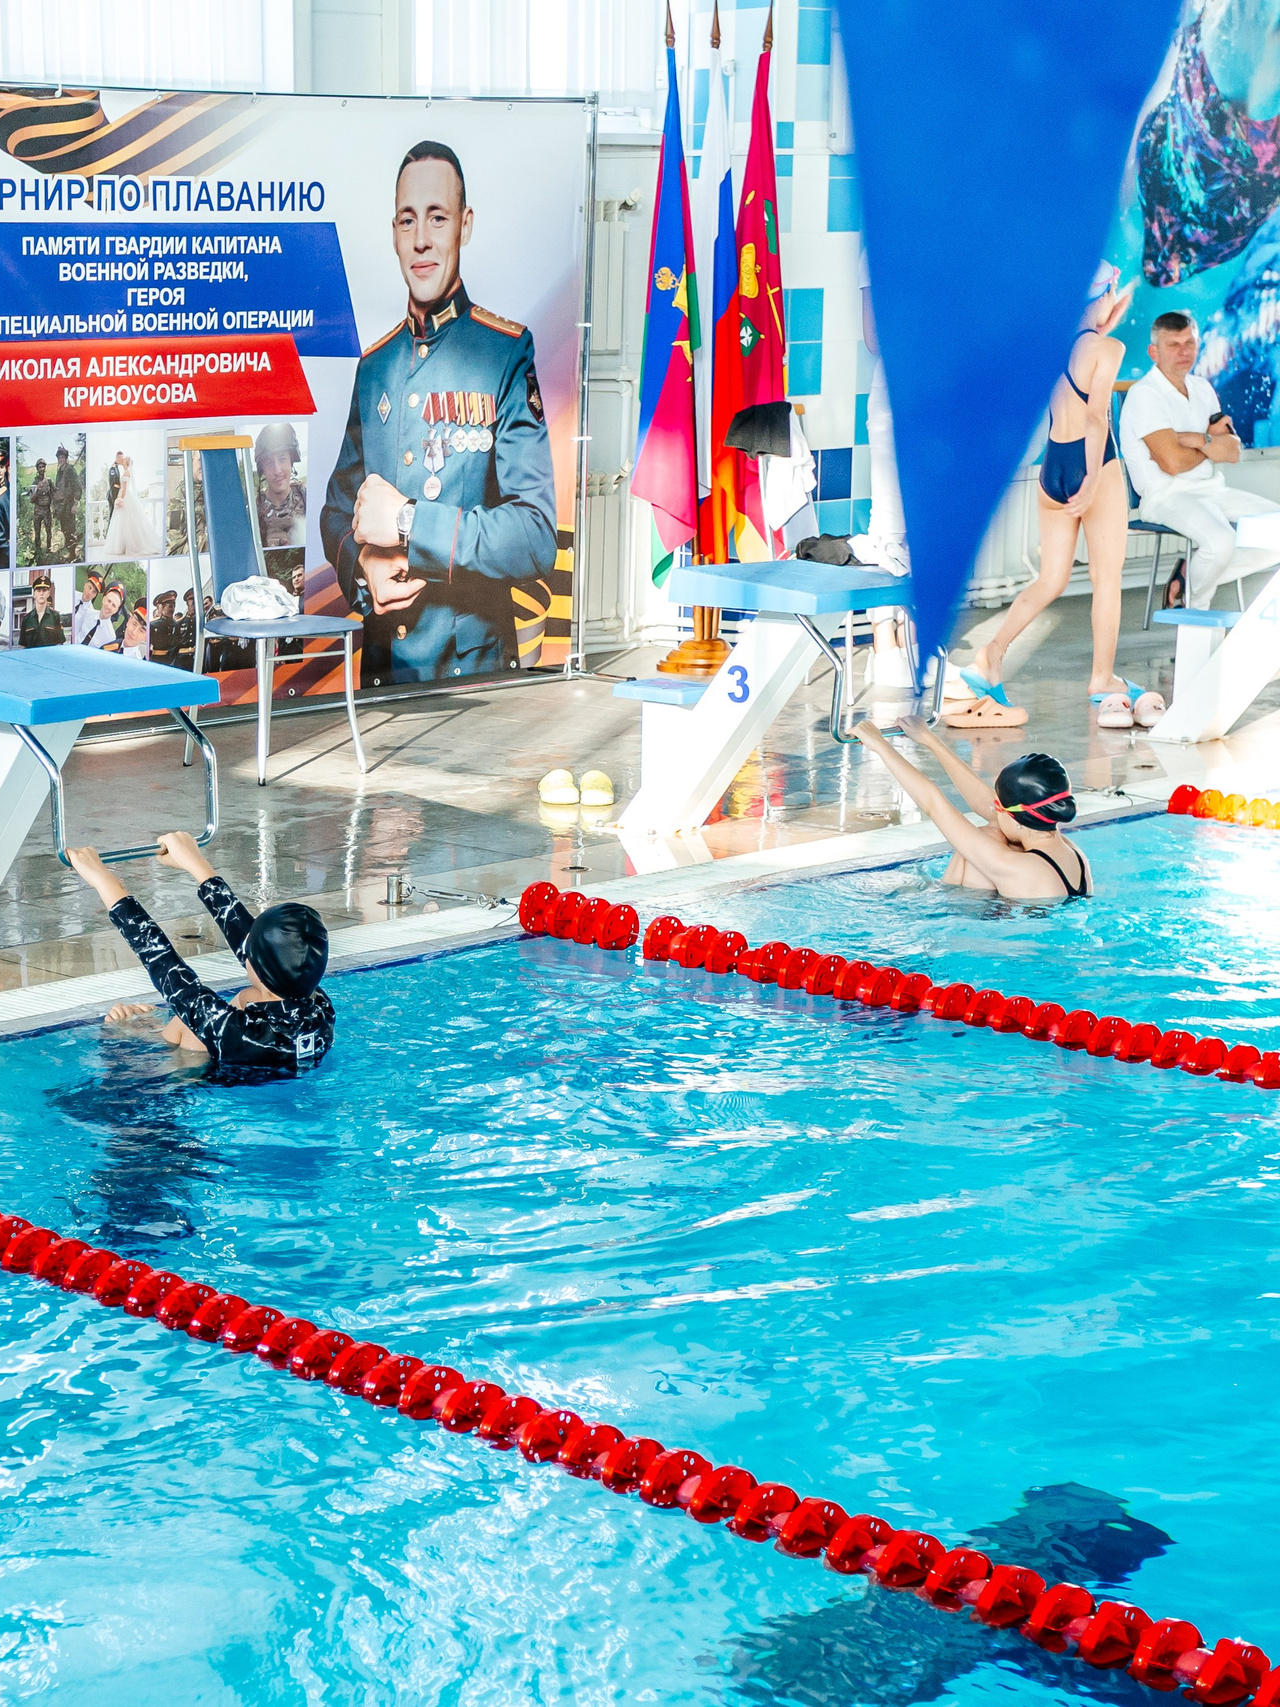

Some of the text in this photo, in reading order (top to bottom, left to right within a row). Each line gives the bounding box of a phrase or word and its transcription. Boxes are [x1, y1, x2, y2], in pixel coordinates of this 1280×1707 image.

[97, 179, 141, 212] ПО
[152, 180, 325, 212] ПЛАВАНИЮ
[21, 235, 283, 258] ПАМЯТИ ГВАРДИИ КАПИТАНА
[58, 257, 249, 283] ВОЕННОЙ РАЗВЕДКИ,
[126, 287, 185, 307] ГЕРОЯ
[131, 307, 219, 332] ВОЕННОЙ
[222, 309, 314, 331] ОПЕРАЦИИ
[86, 351, 272, 378] АЛЕКСАНДРОВИЧА
[63, 382, 198, 408] КРИВОУСОВА
[1259, 597, 1280, 625] 4
[727, 664, 750, 703] 3
